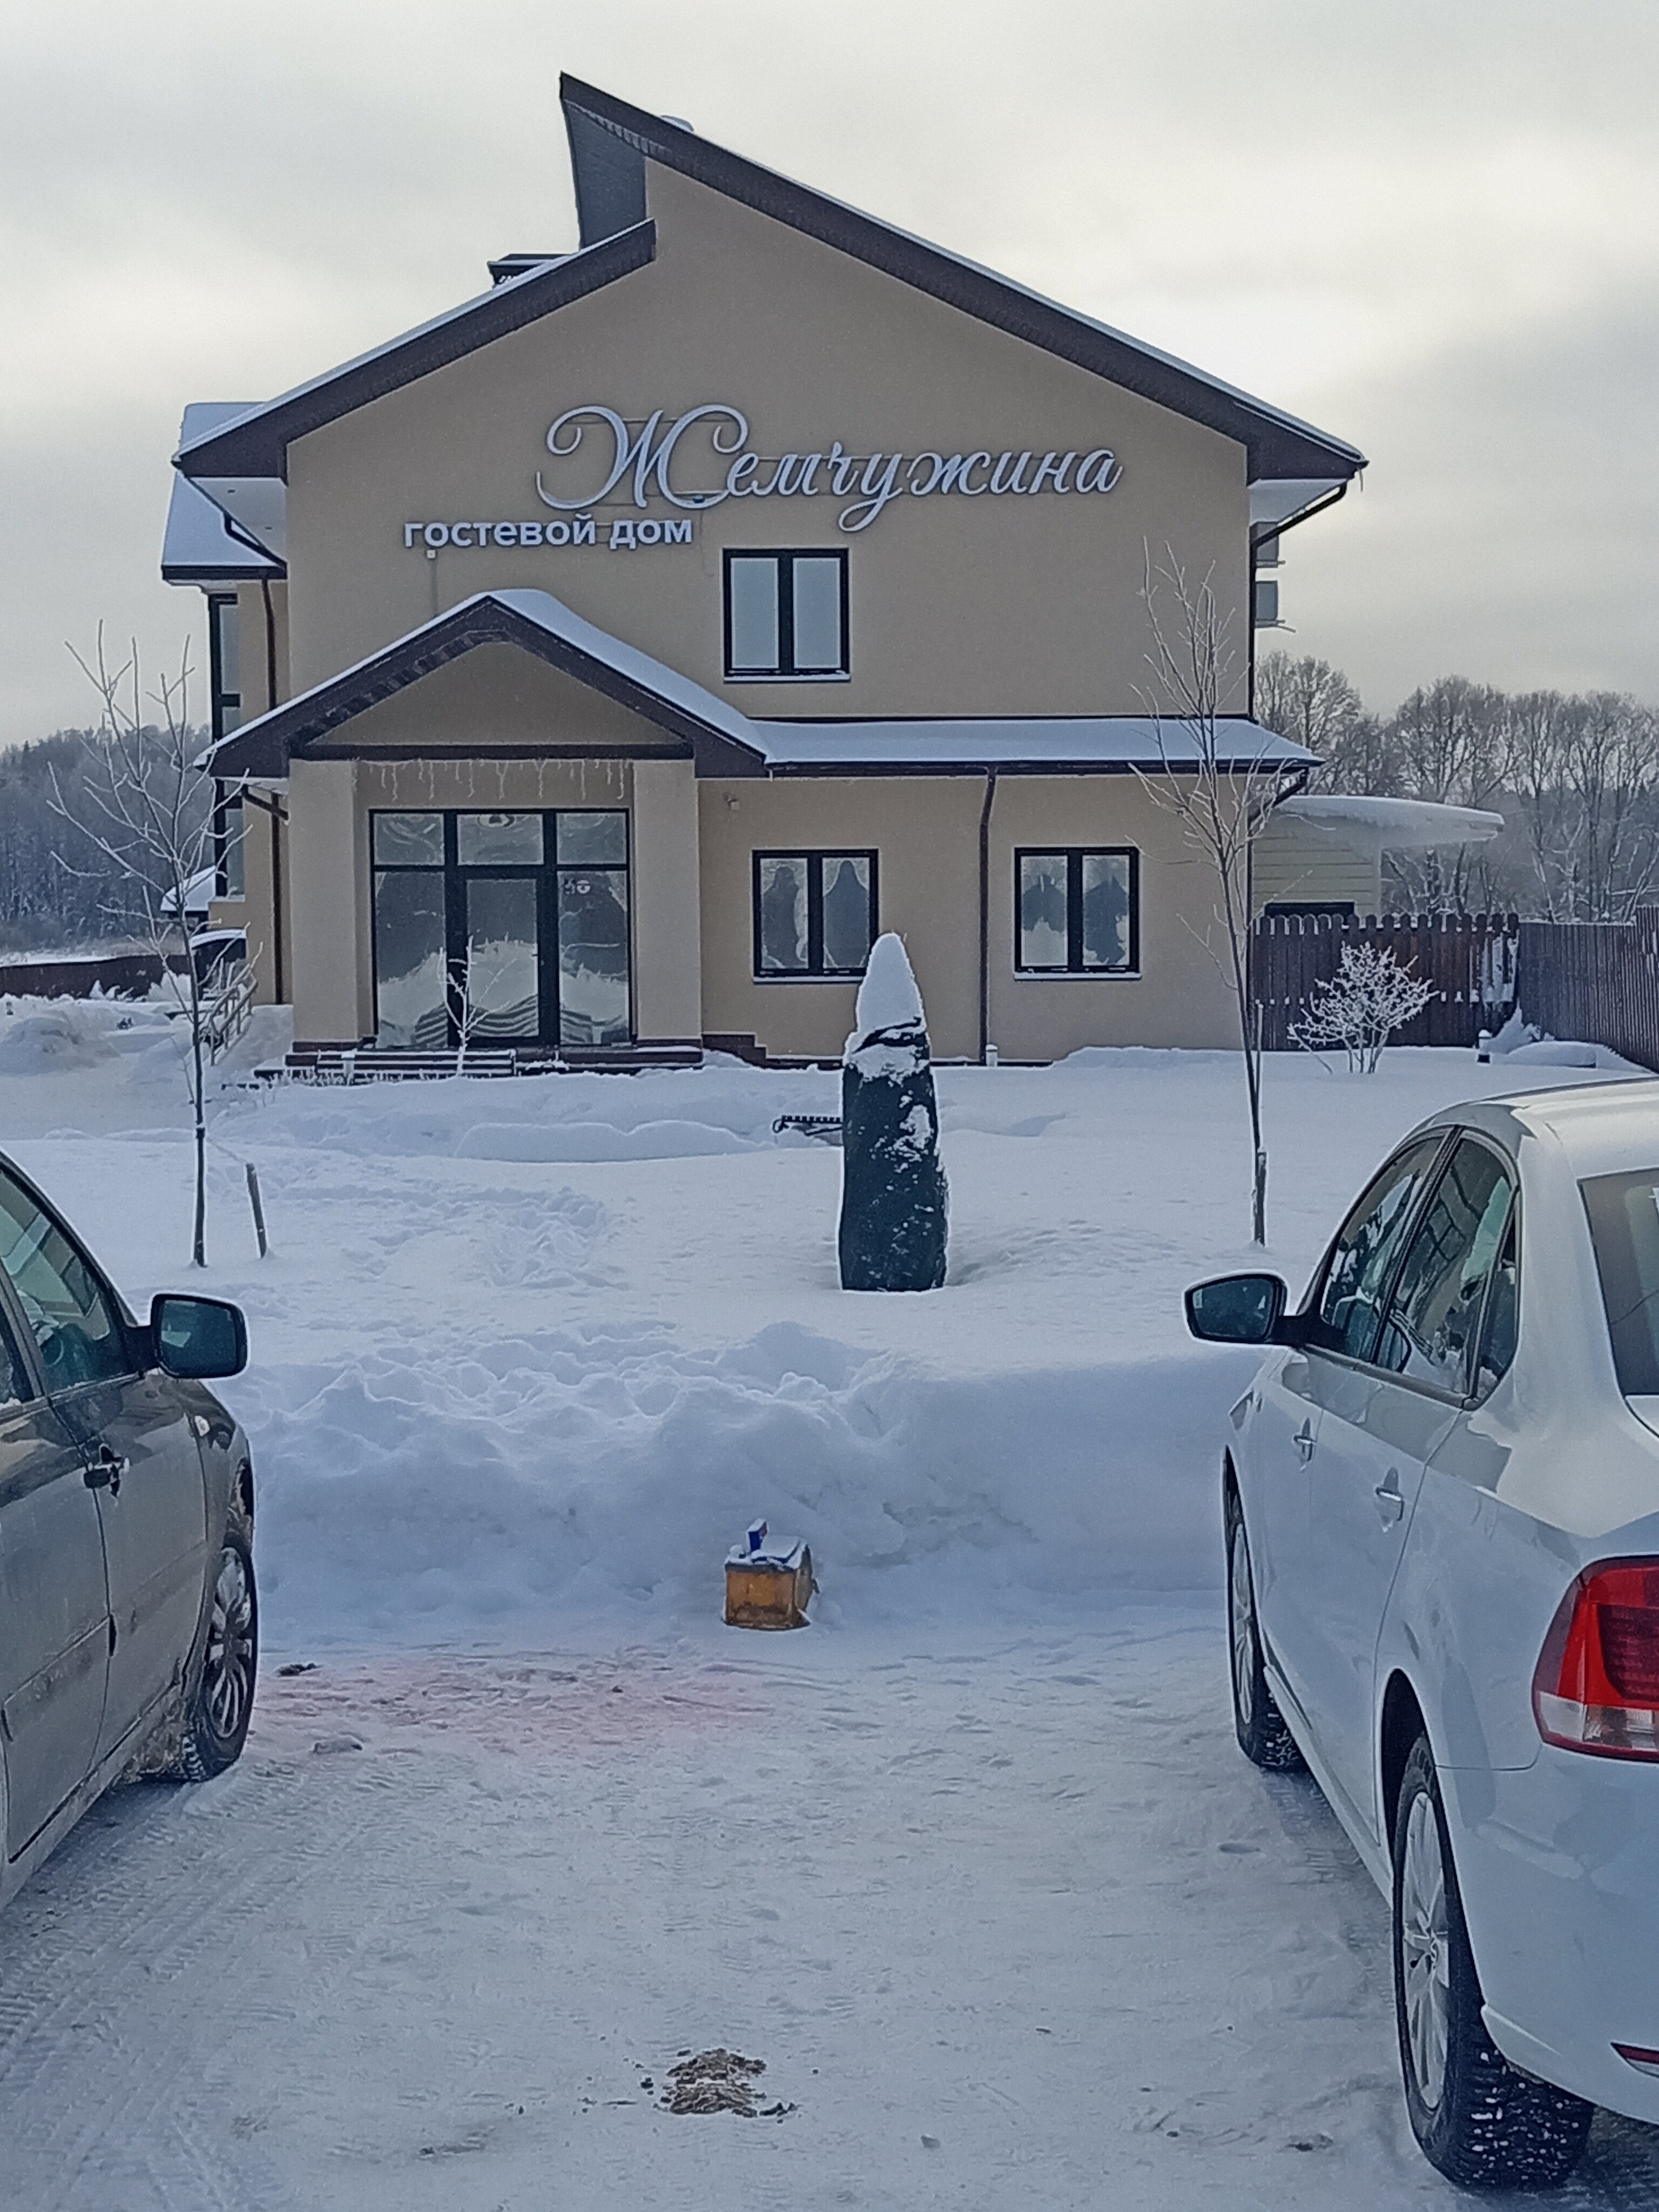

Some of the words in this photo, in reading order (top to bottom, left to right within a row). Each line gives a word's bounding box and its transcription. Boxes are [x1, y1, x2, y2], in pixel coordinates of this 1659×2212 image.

[536, 403, 1123, 531] Жемчужина
[404, 513, 596, 547] гостевой
[610, 519, 693, 550] дом
